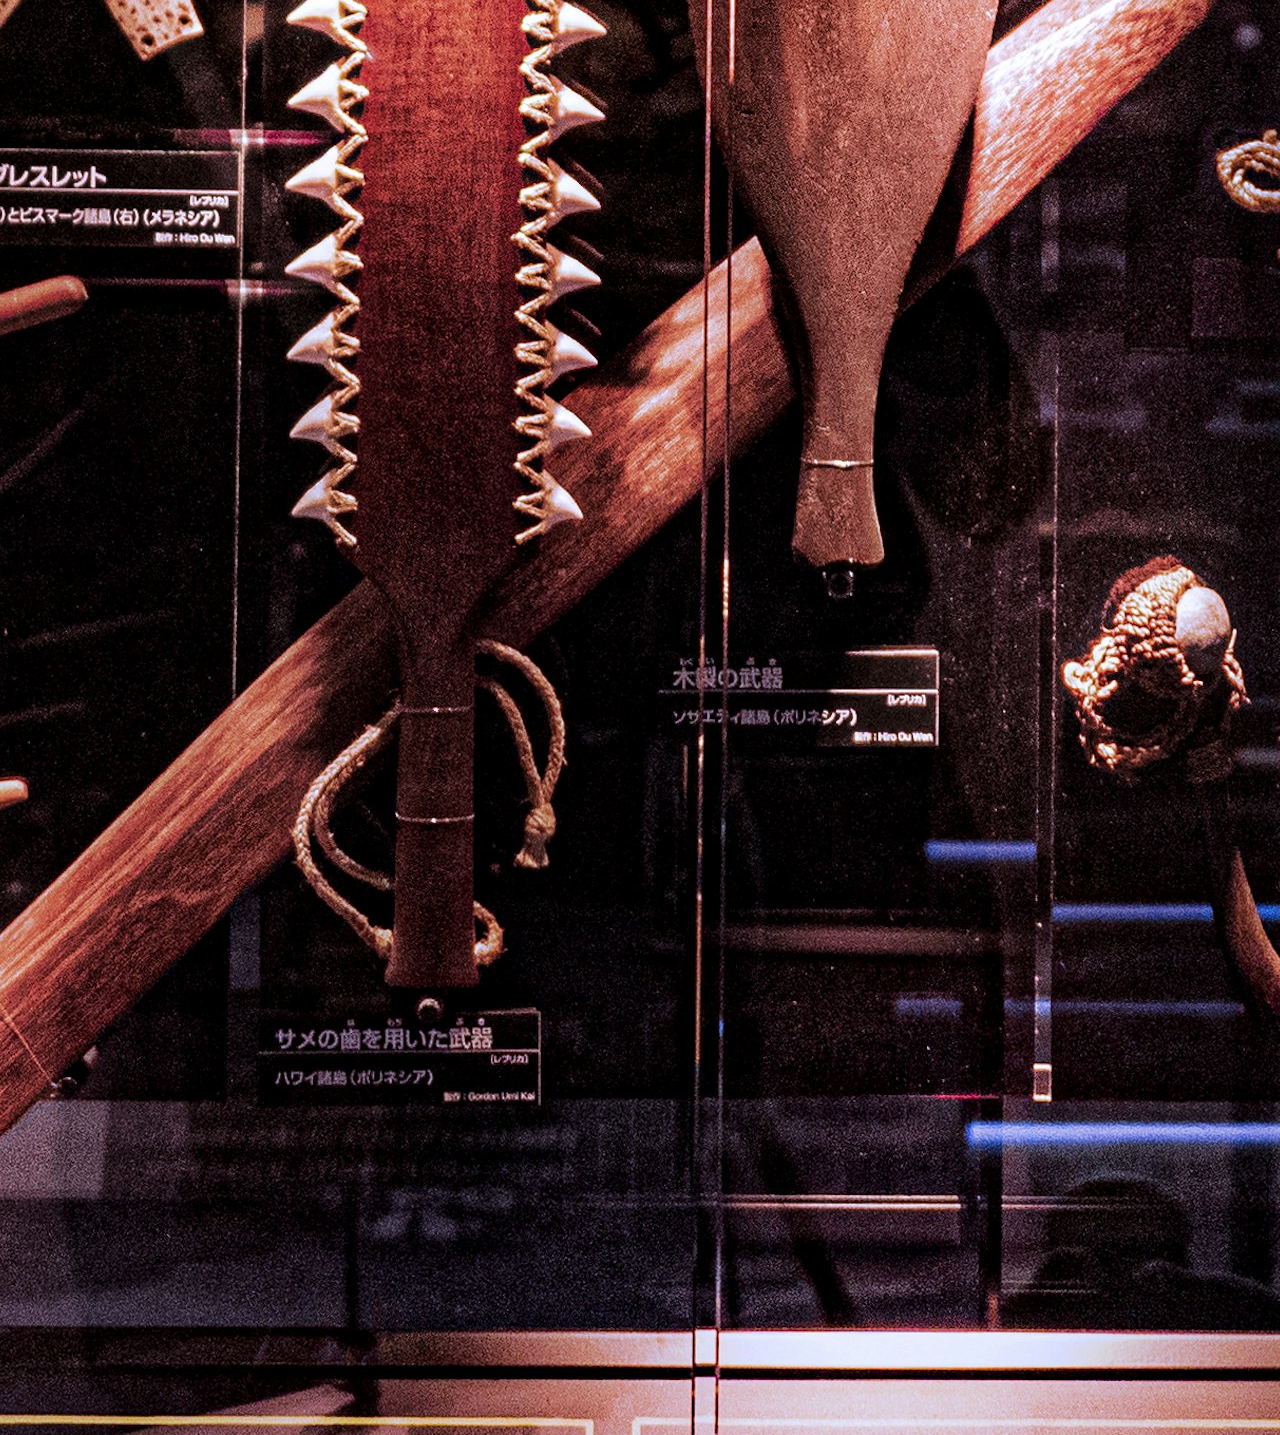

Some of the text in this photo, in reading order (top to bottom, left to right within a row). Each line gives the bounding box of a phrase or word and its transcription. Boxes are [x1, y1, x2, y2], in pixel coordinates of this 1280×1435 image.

[673, 665, 784, 690] 木製の武器
[275, 1026, 493, 1050] サメの歯を用いた武器
